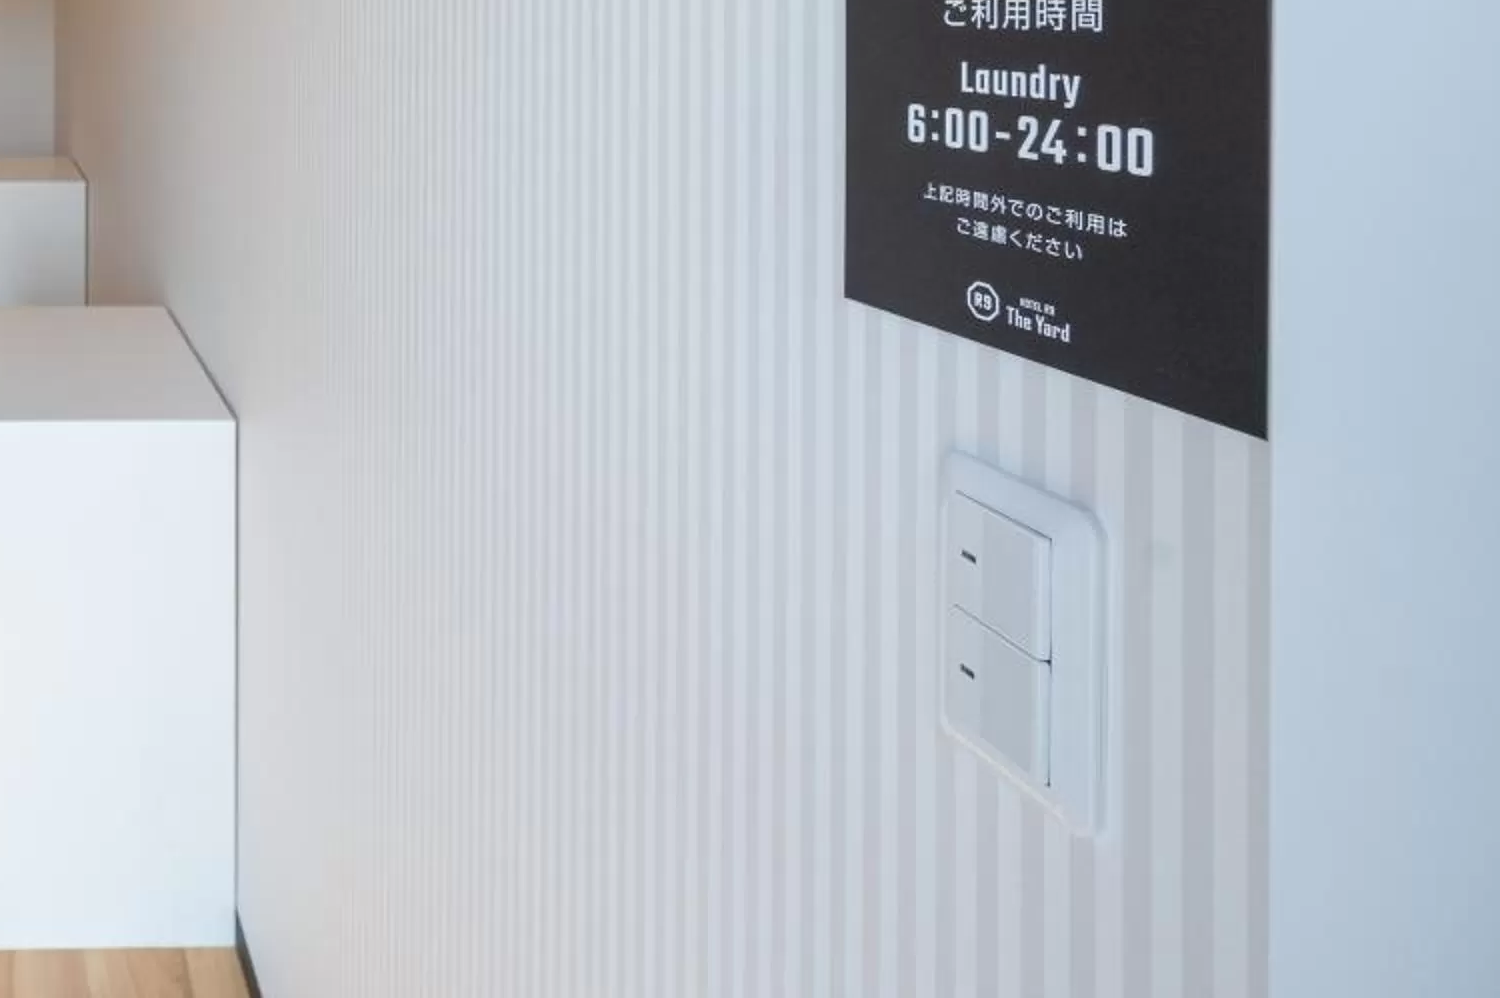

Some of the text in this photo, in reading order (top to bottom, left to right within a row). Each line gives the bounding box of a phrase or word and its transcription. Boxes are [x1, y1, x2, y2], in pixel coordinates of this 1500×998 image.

[960, 61, 1082, 109] Laundry
[923, 182, 1128, 238] 上記時間外でのご利用は
[956, 217, 1084, 260] ご遠慮ください
[1005, 305, 1071, 343] The Yard
